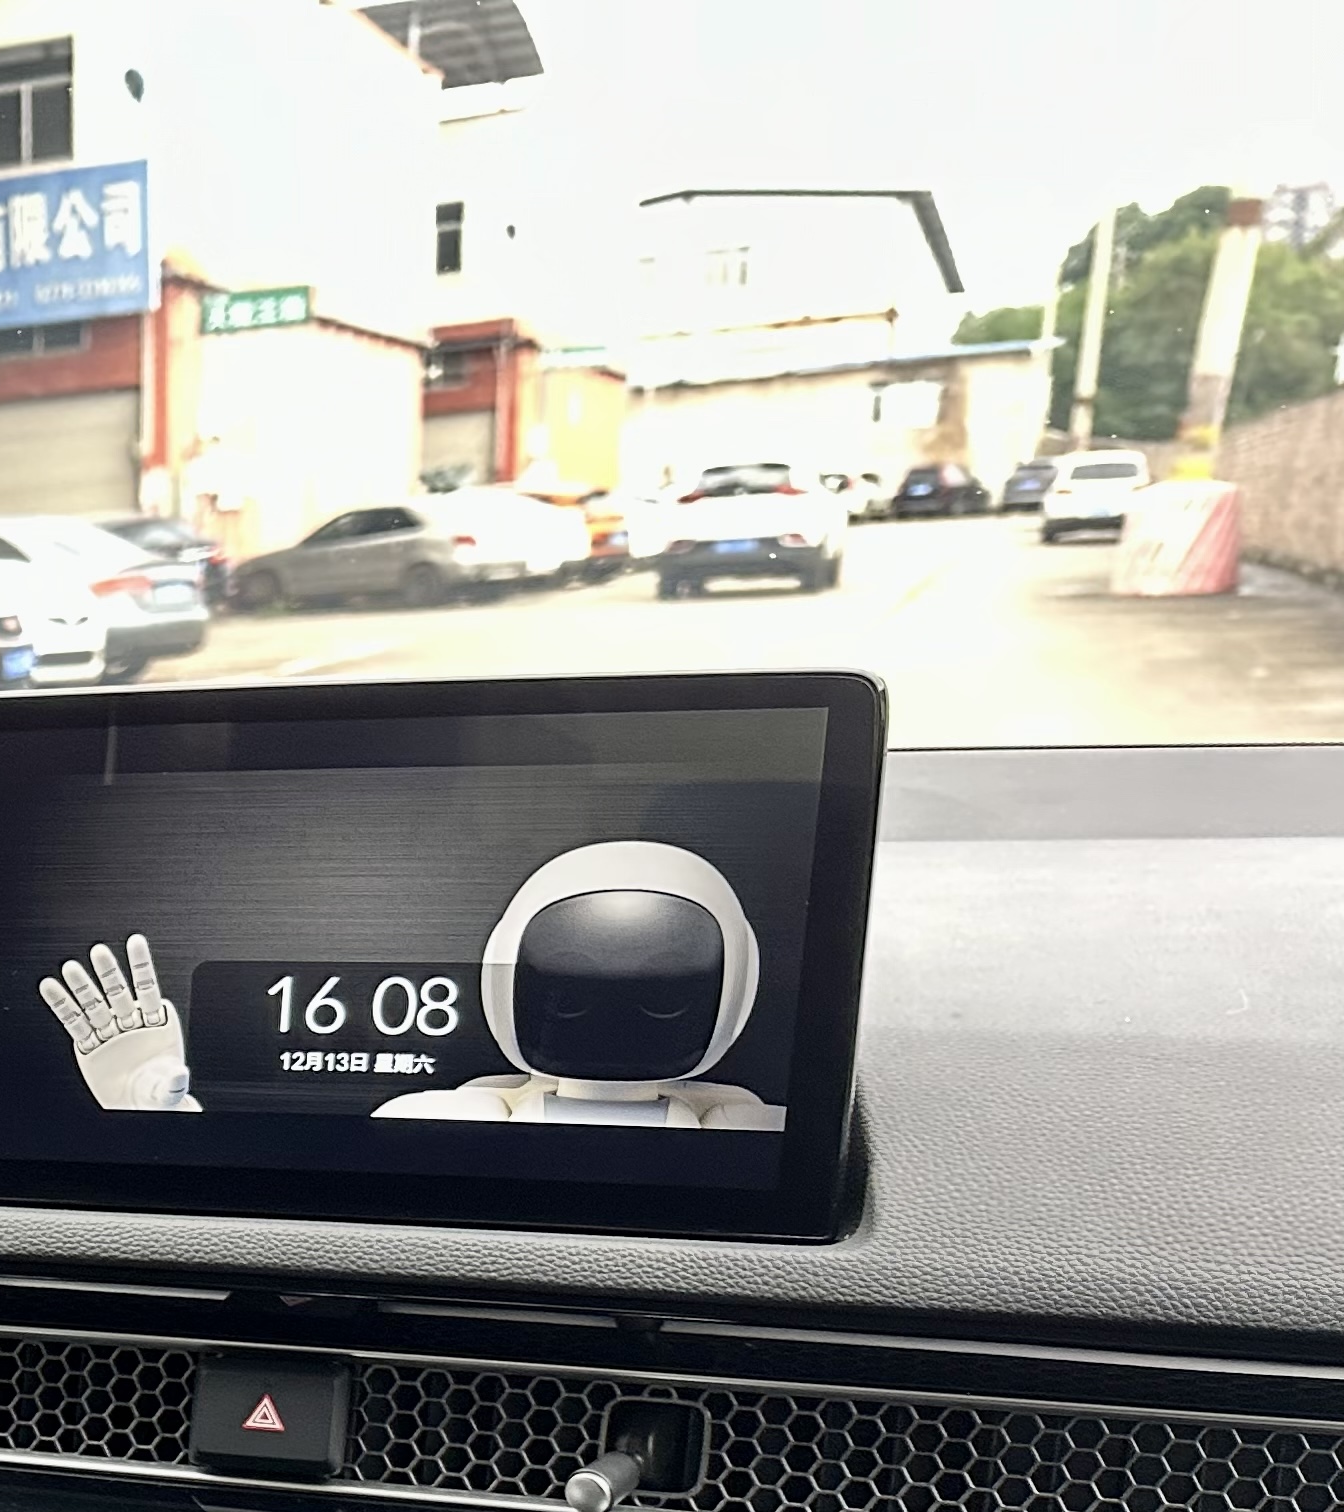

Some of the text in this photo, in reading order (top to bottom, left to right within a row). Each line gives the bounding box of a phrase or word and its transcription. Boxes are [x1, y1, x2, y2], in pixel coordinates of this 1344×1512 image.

[279, 1051, 436, 1074] 12月13日 星期六
